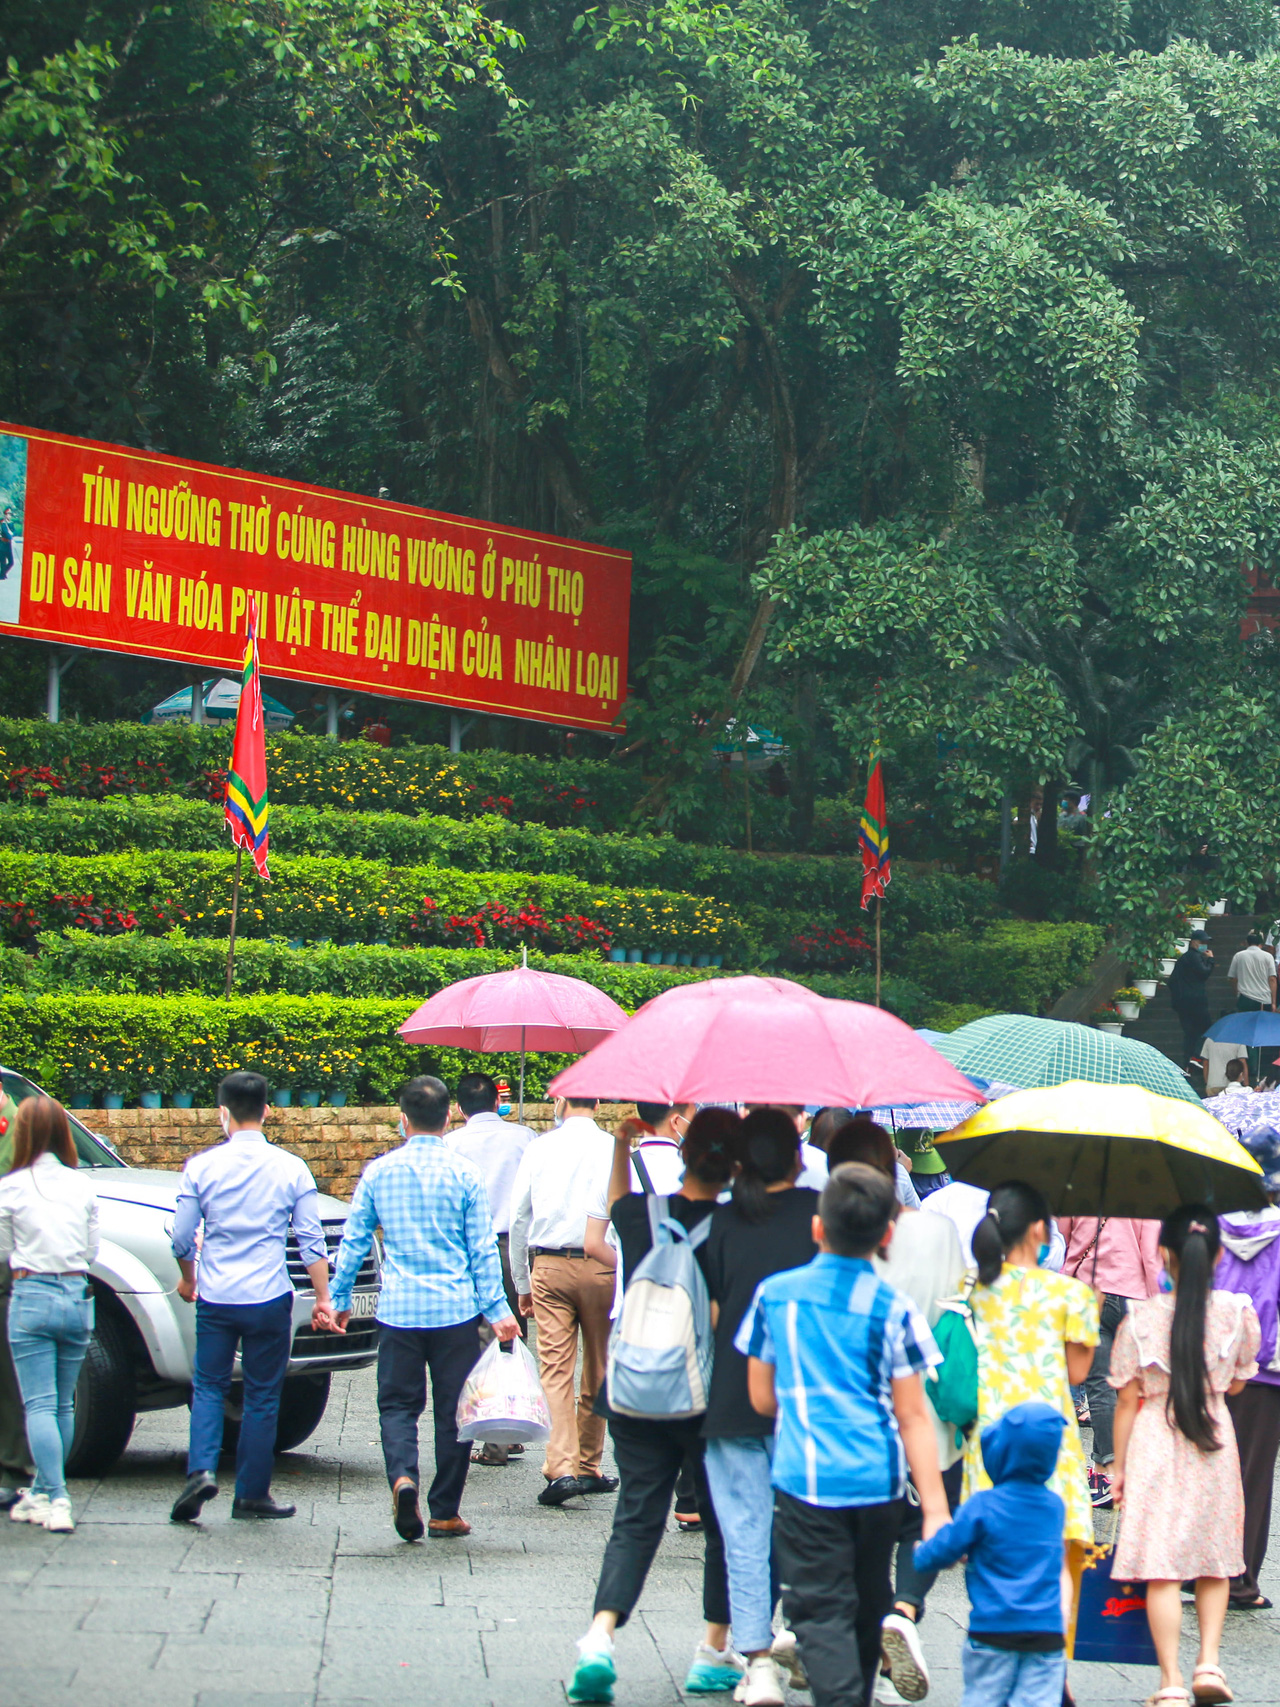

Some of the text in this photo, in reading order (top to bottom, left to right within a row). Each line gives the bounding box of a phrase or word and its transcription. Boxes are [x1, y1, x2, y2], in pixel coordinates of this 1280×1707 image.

[30, 543, 619, 710] DI SẢN VĂN HÓA PHI VẬT THỂ ĐẠI DIỆN CỦA NHÂN LOẠI
[82, 465, 584, 626] TÍN NGƯỠNG THỜ CÚNG HÙNG VƯƠNG Ở PHÚ THỌ
